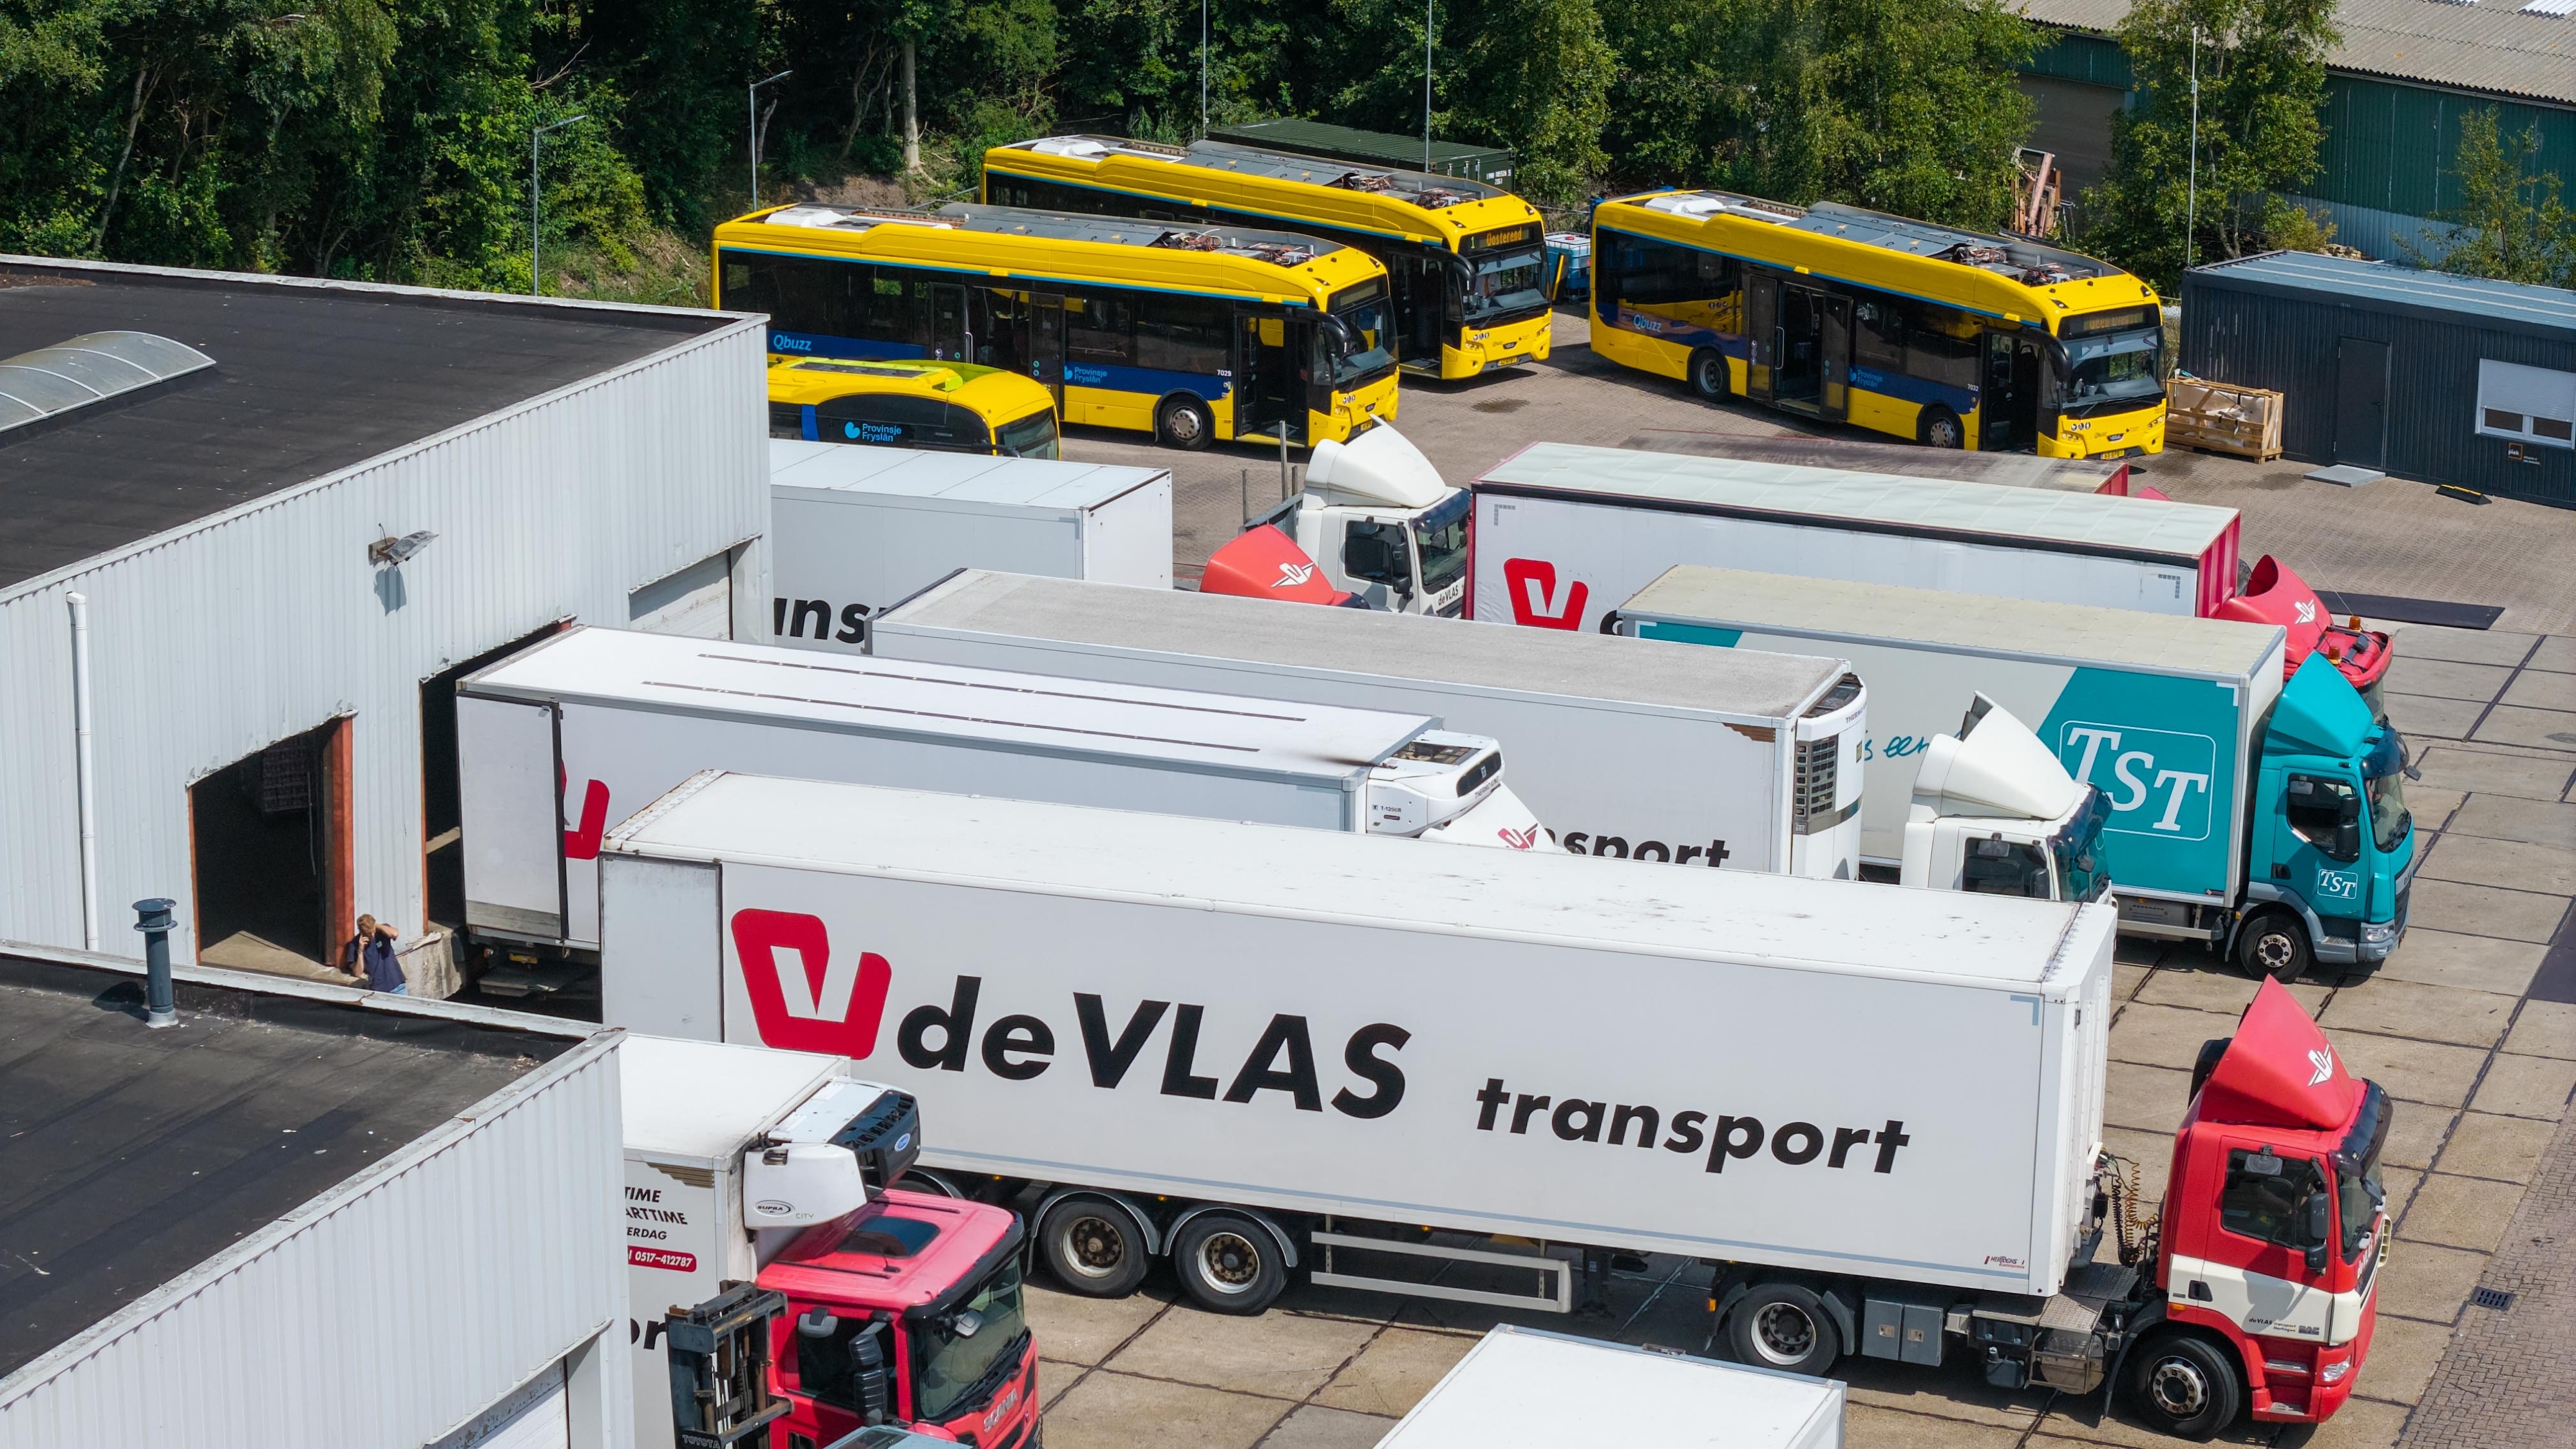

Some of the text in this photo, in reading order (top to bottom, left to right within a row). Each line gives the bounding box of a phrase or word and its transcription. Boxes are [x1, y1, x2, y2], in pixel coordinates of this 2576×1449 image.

[1470, 227, 1522, 249] 1 Oosterend
[1633, 314, 1662, 332] Qbuzz
[773, 334, 812, 352] Qbuzz
[1074, 366, 1108, 378] Provinsje
[1074, 374, 1101, 384] Fryslân
[1967, 383, 1979, 392] 7032
[862, 424, 902, 436] Provinsje
[862, 431, 894, 442] Fryslân
[2067, 727, 2209, 832] TST
[2320, 871, 2356, 898] TST
[1476, 1078, 1910, 1174] transport
[983, 1387, 1019, 1434] SCANIA
[682, 1434, 721, 1449] TOYOTA
